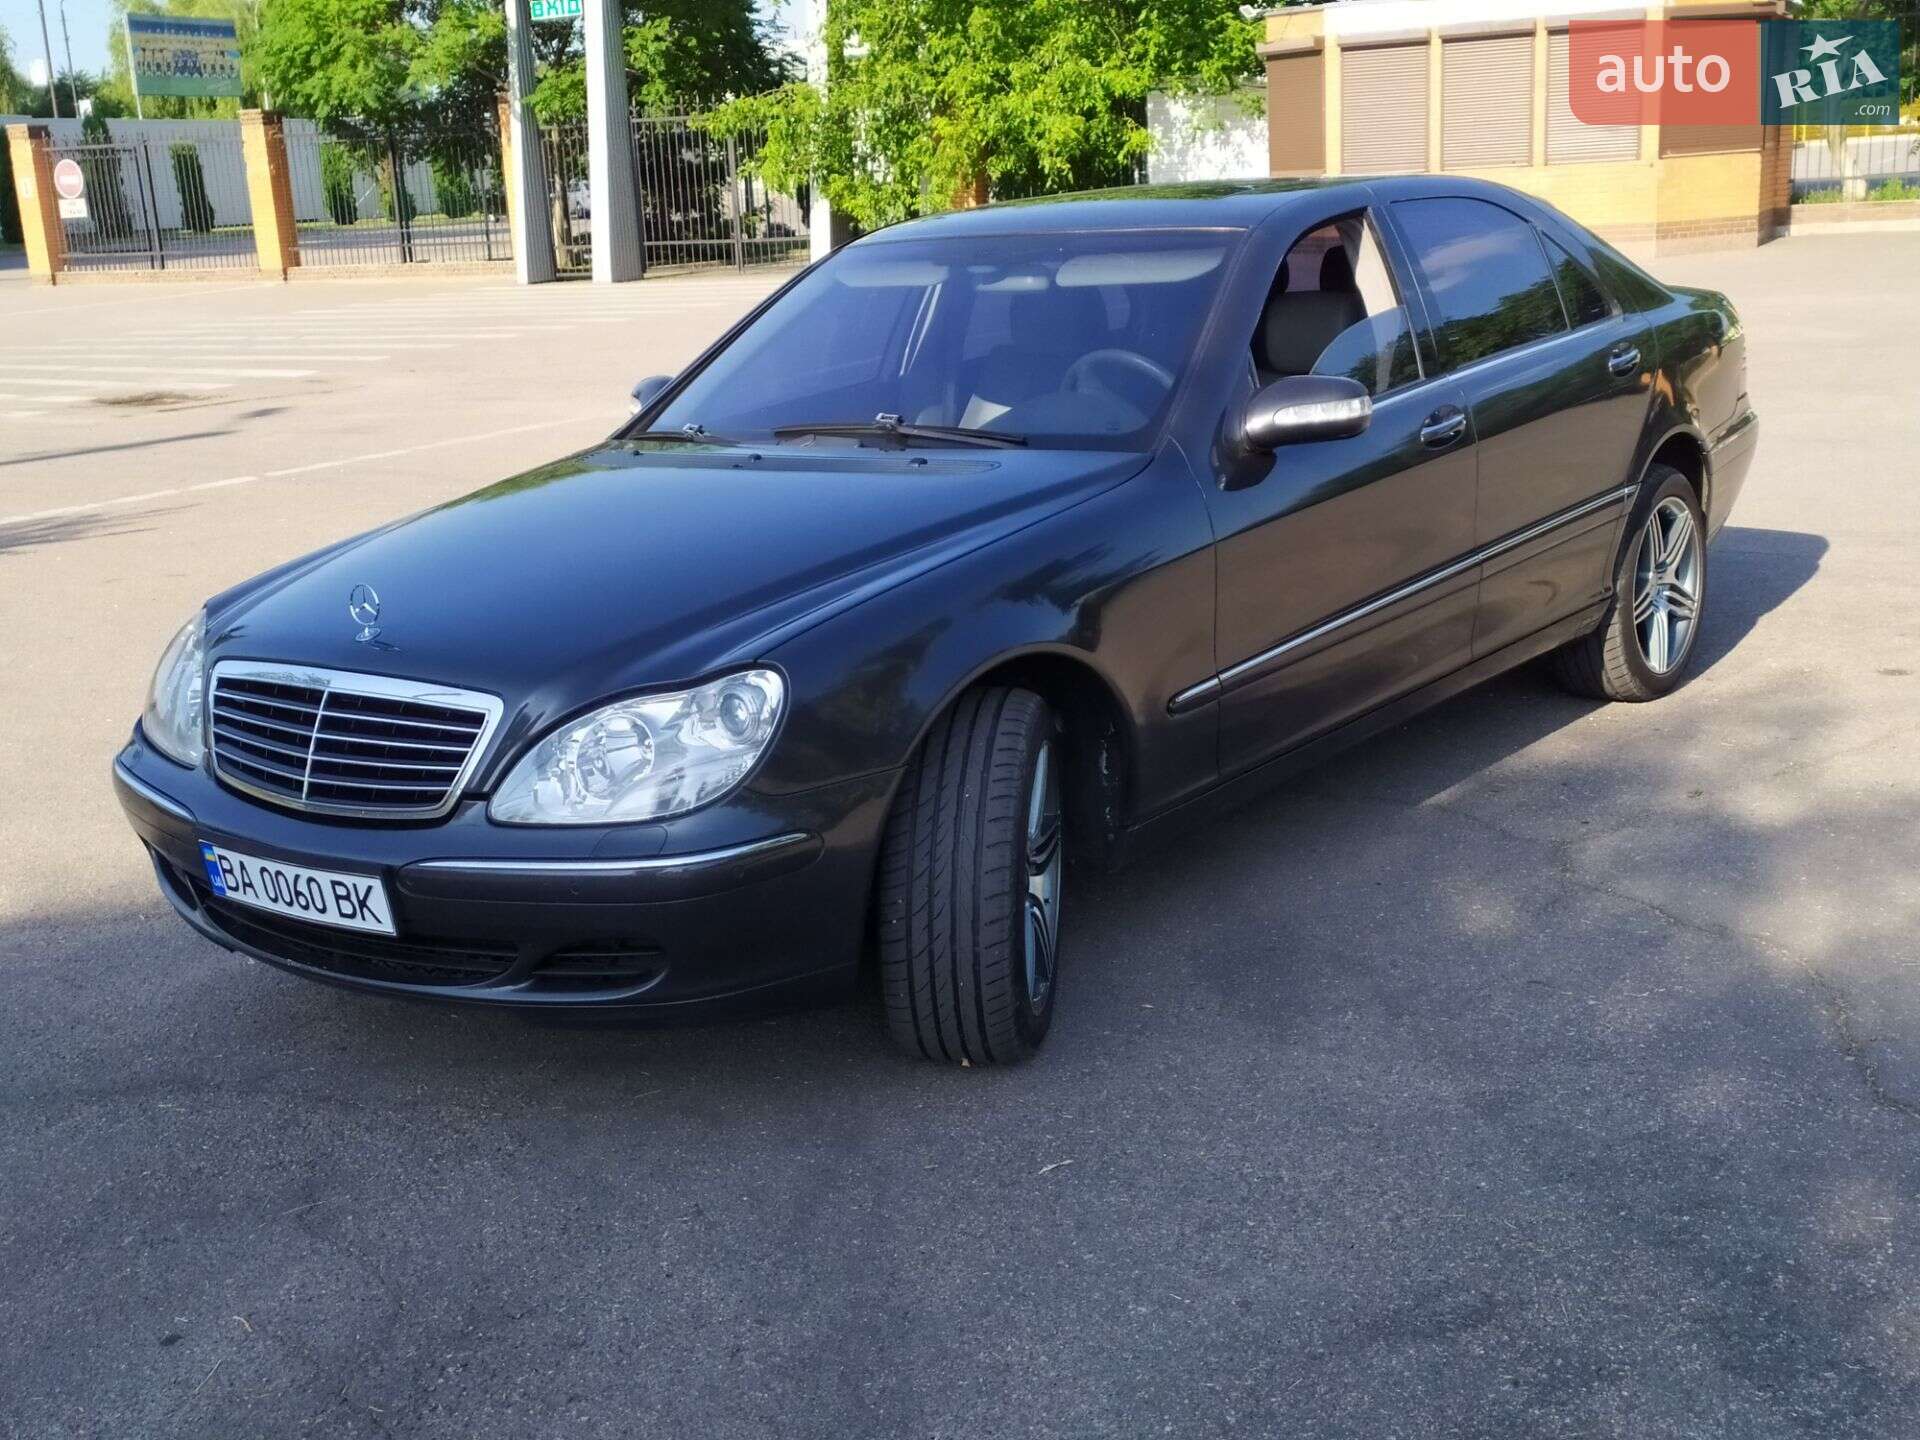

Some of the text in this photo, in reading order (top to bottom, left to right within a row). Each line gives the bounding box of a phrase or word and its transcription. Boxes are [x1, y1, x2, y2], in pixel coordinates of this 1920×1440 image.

[210, 873, 226, 888] UA
[217, 853, 383, 925] BA 0060 BK
